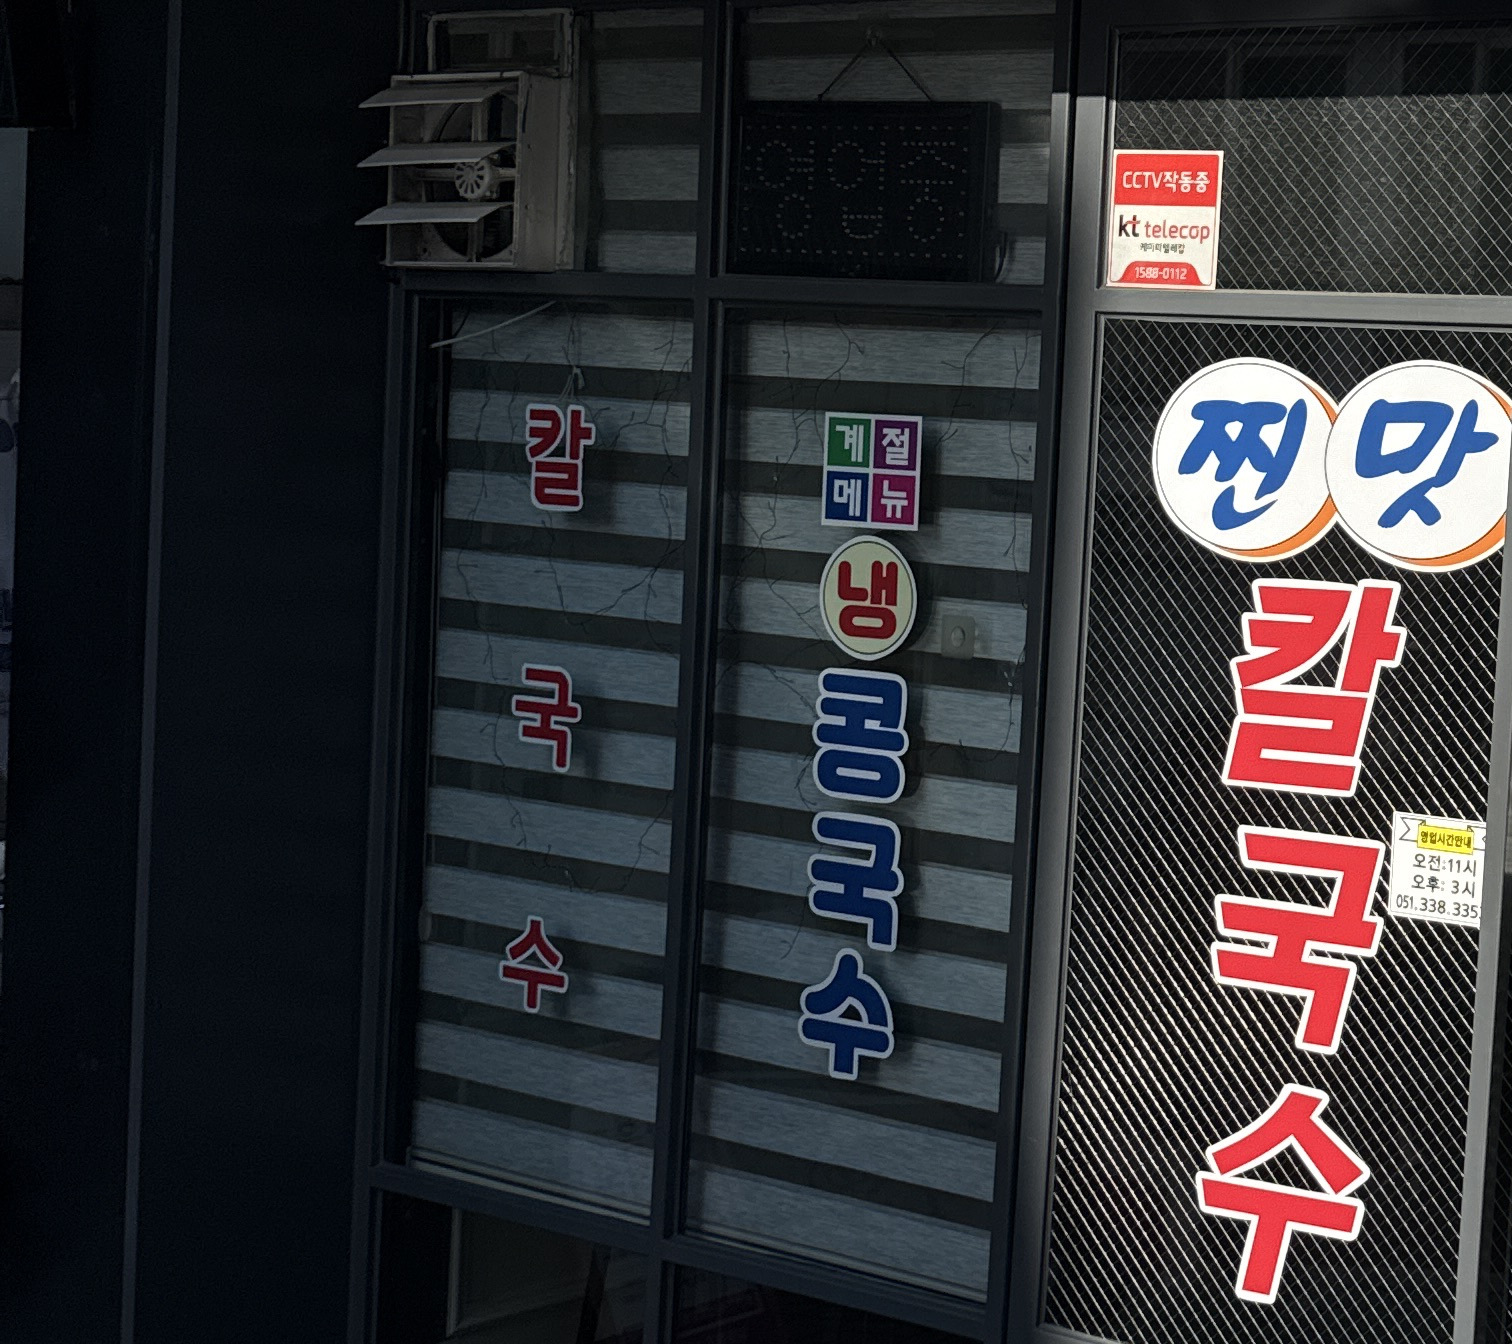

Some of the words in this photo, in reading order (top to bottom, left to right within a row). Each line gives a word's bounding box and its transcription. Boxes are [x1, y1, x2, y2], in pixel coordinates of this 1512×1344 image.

[756, 139, 955, 243] 영업중
[1122, 170, 1210, 193] CCTV작동중
[1118, 214, 1141, 237] kt
[1144, 219, 1210, 244] telecop
[1134, 266, 1188, 280] 1588-0112
[1396, 894, 1482, 920] 051.338.335
[1196, 579, 1406, 1304] 칼국수
